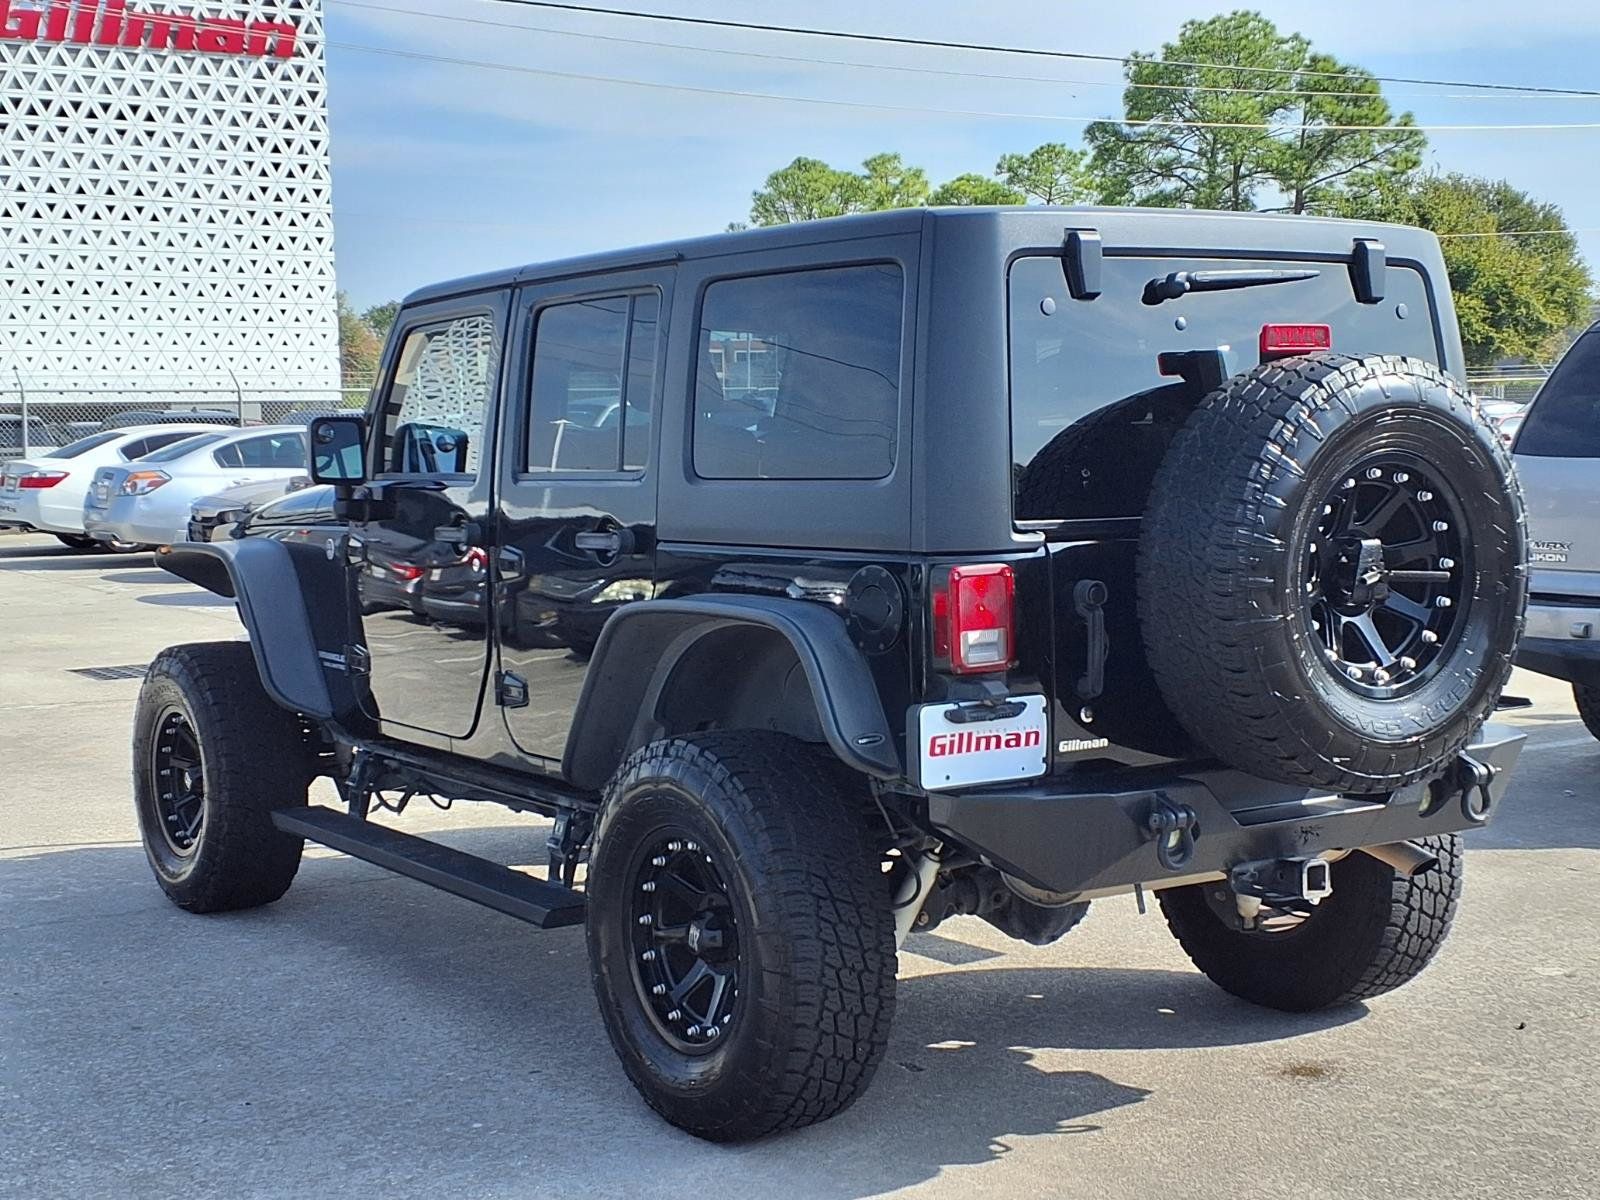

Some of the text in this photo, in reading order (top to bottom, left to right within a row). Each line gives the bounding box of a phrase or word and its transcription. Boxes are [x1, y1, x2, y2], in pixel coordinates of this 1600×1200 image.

[0, 0, 298, 59] Gillman
[1529, 553, 1567, 562] UKON
[929, 730, 1040, 757] Gillman
[1058, 737, 1109, 753] Gillman
